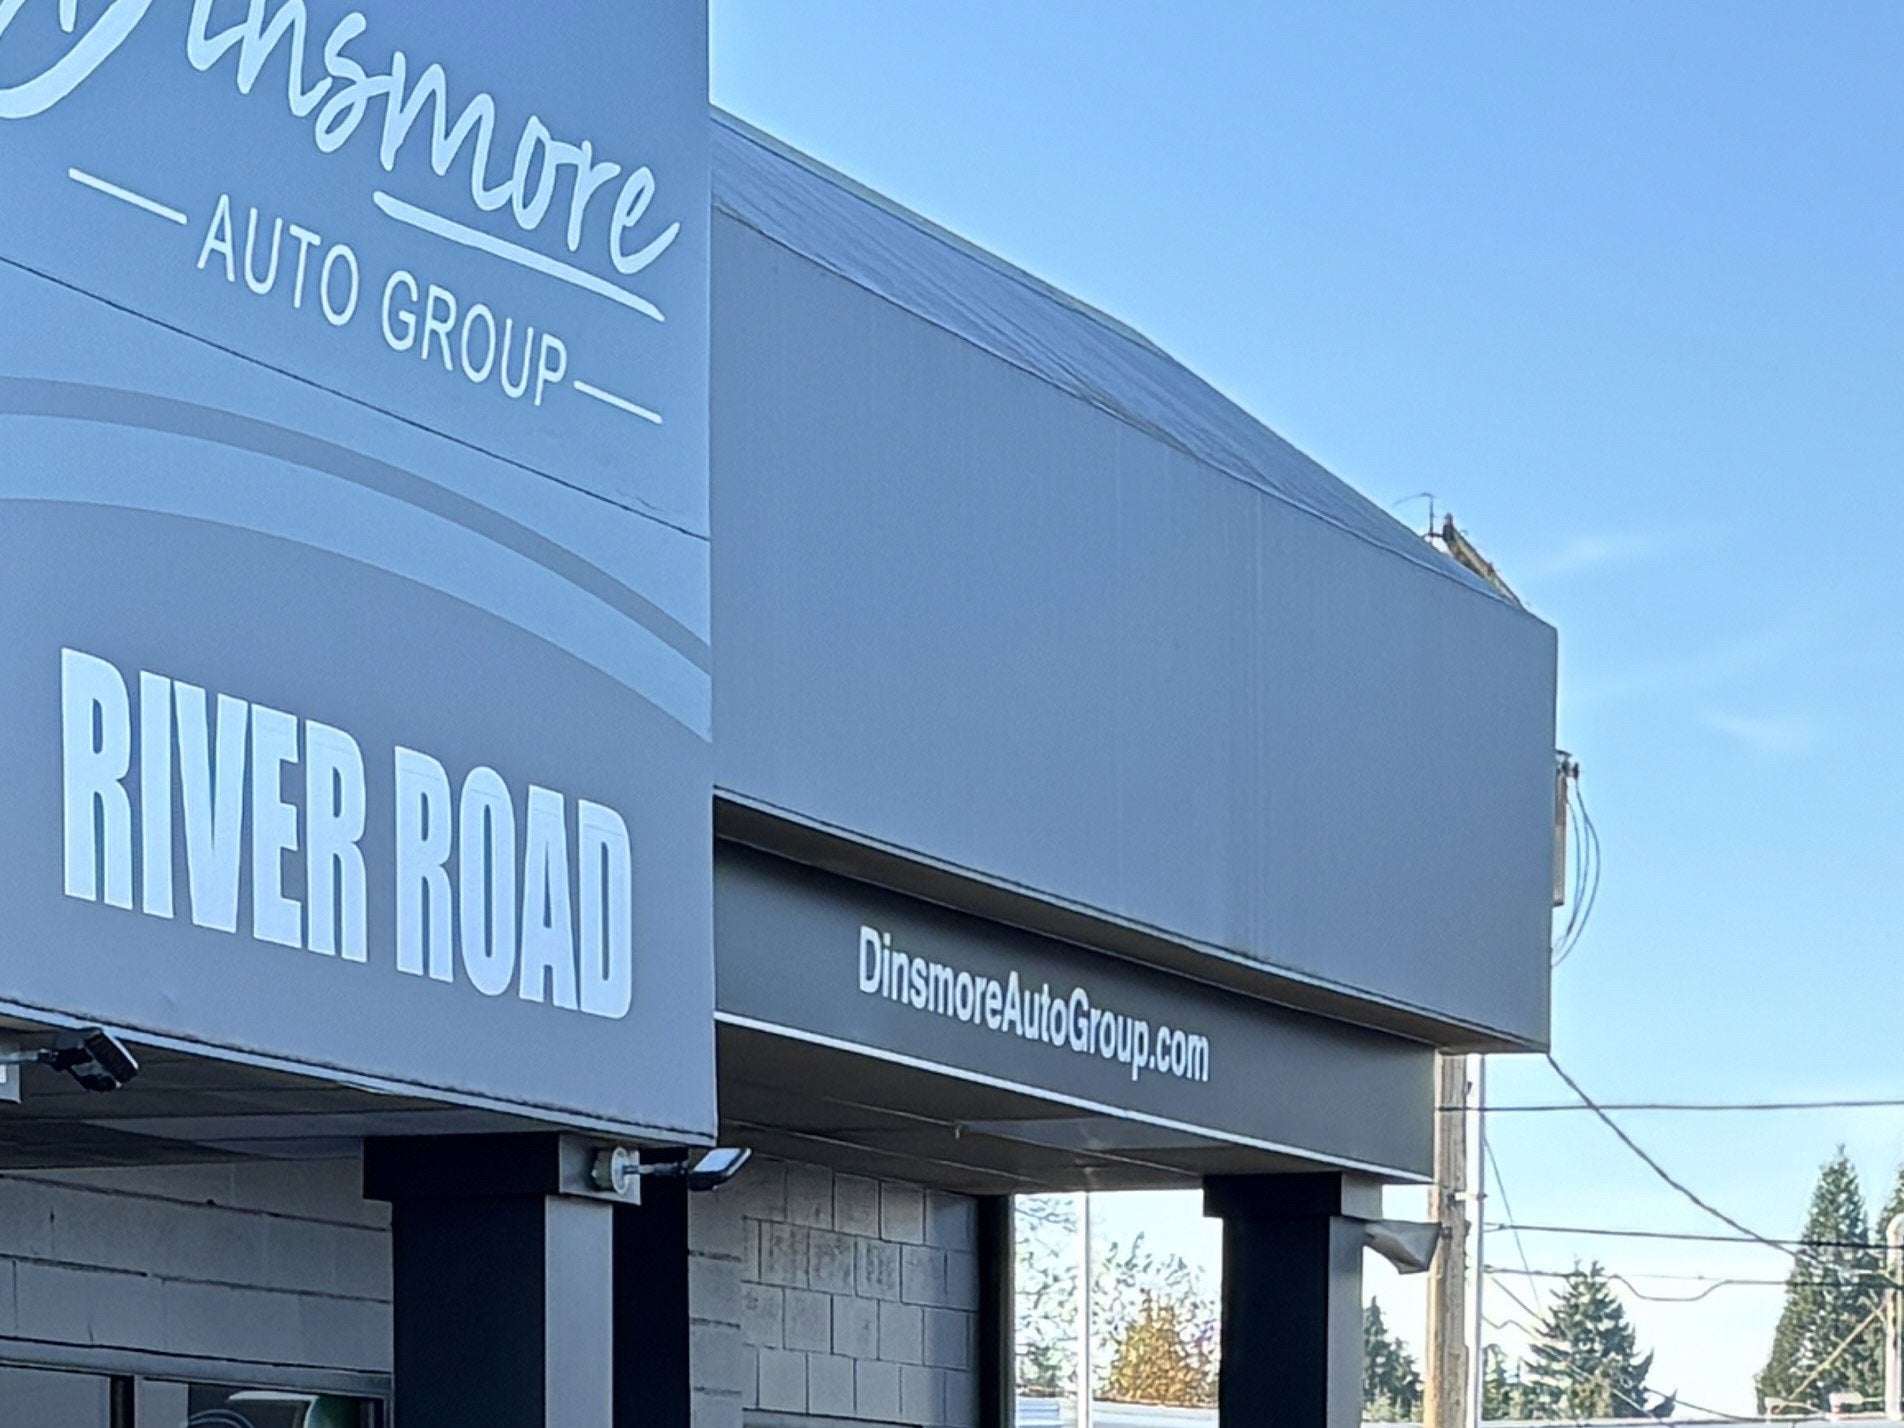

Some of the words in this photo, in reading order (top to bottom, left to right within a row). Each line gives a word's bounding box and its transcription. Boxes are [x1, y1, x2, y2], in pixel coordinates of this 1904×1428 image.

[196, 193, 361, 327] AUTO
[382, 270, 568, 407] GROUP
[61, 647, 368, 963] RIVER
[395, 745, 632, 1020] ROAD
[859, 925, 1210, 1082] DinsmoreAutoGroup.com
